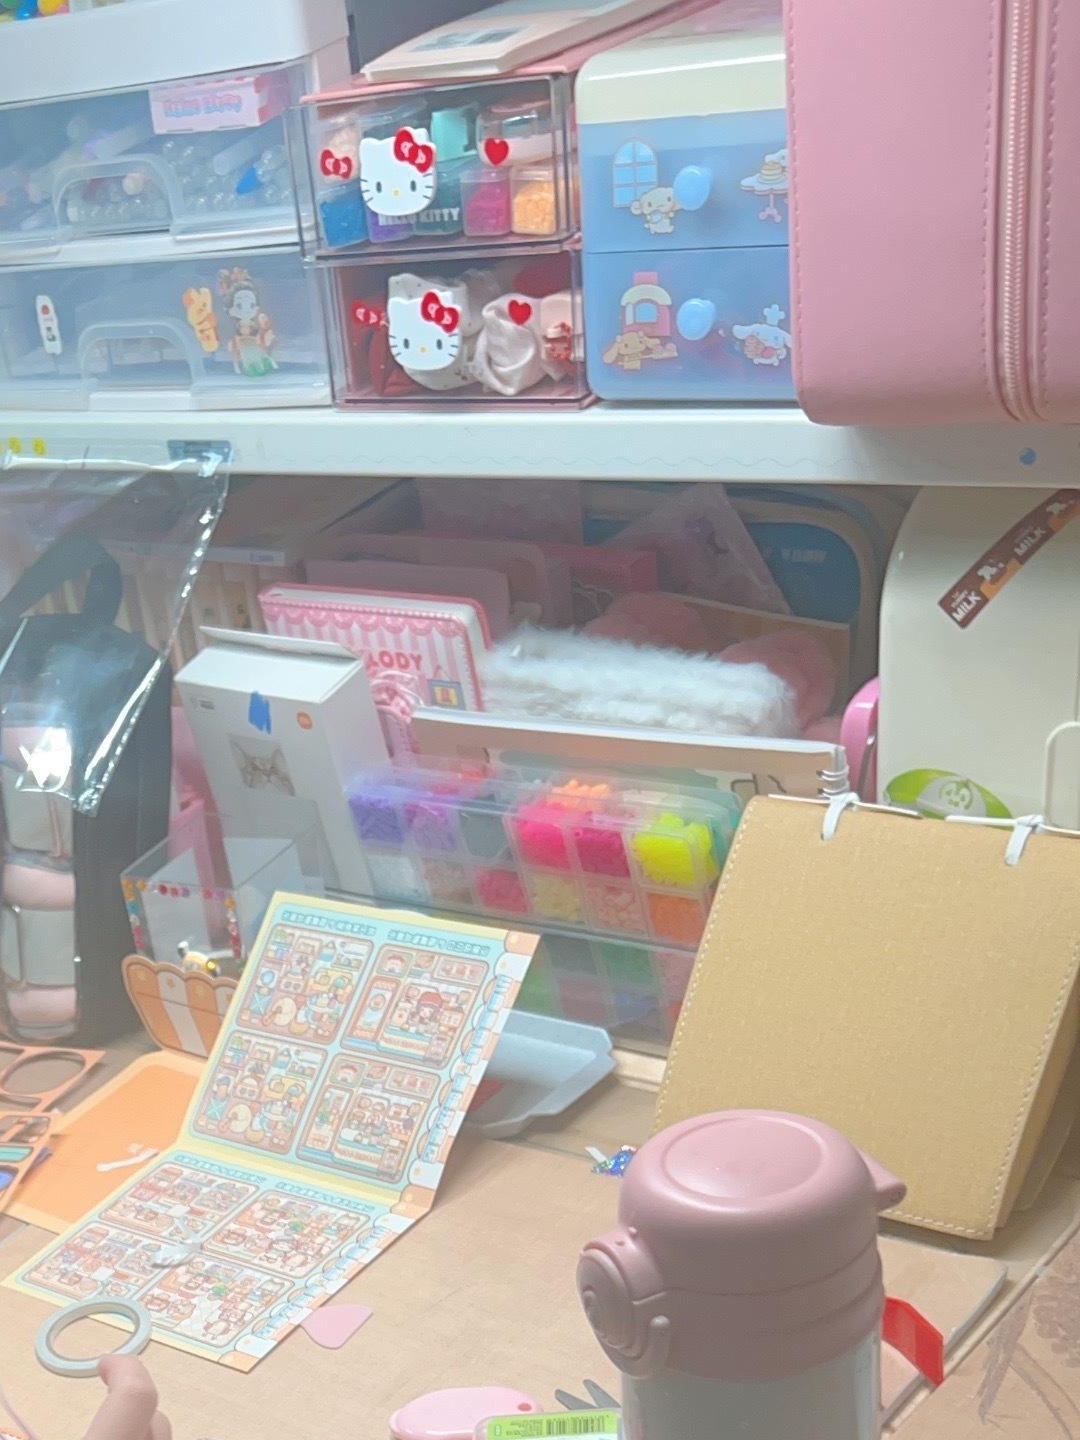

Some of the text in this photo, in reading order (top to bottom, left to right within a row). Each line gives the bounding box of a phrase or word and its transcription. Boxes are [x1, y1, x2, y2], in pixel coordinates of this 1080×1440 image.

[420, 207, 460, 223] KITTY
[1012, 526, 1047, 556] MILK
[951, 590, 982, 622] MILK
[365, 649, 422, 673] LODY
